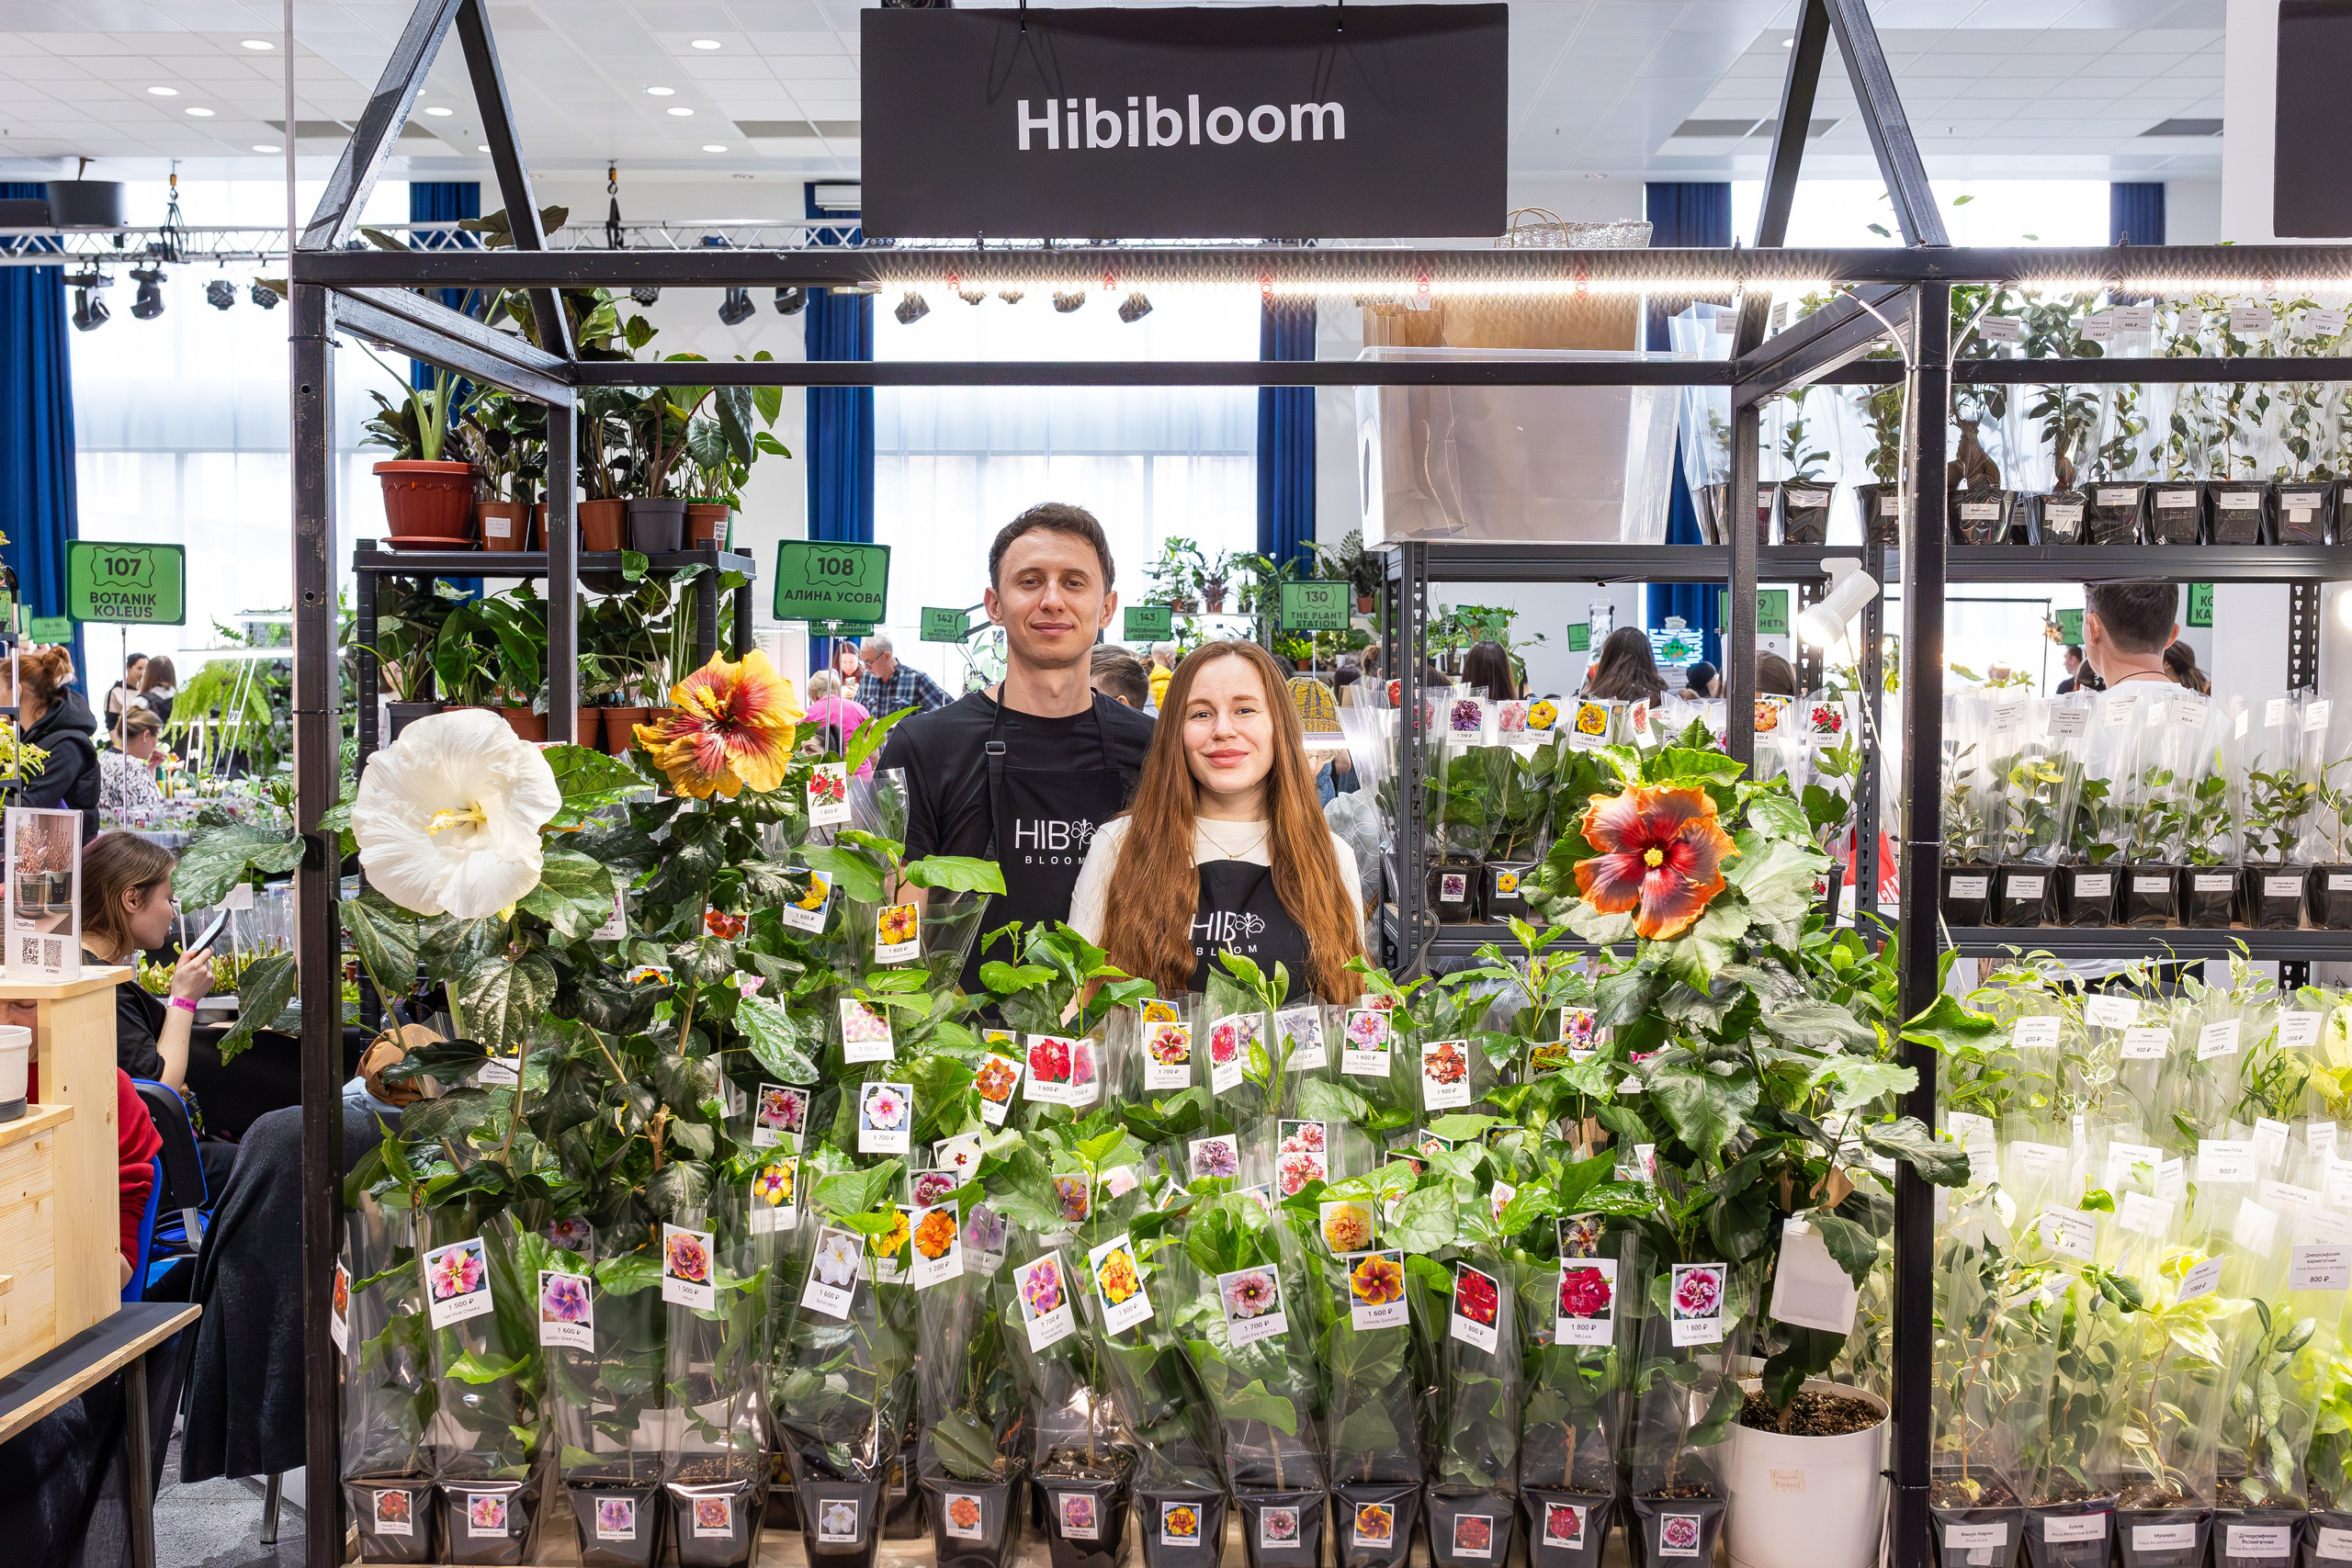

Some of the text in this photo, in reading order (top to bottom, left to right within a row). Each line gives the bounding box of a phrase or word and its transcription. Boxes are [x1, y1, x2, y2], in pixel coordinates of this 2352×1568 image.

[1017, 95, 1345, 151] Hibibloom
[105, 558, 141, 576] 107
[817, 558, 854, 576] 108
[90, 592, 156, 606] BOTANIK
[784, 589, 882, 604] АЛИНА УСОВА
[1306, 591, 1328, 603] 130
[94, 604, 153, 618] KOLEUS
[936, 614, 953, 623] 142
[1196, 944, 1257, 956] BLOM
[933, 1263, 944, 1272] 200
[683, 1285, 694, 1294] 500
[824, 1290, 835, 1299] 600
[454, 1300, 467, 1309] 500
[1123, 1304, 1133, 1314] 800
[1046, 1316, 1055, 1326] 700
[1251, 1322, 1262, 1330] 700
[1468, 1325, 1479, 1334] 800
